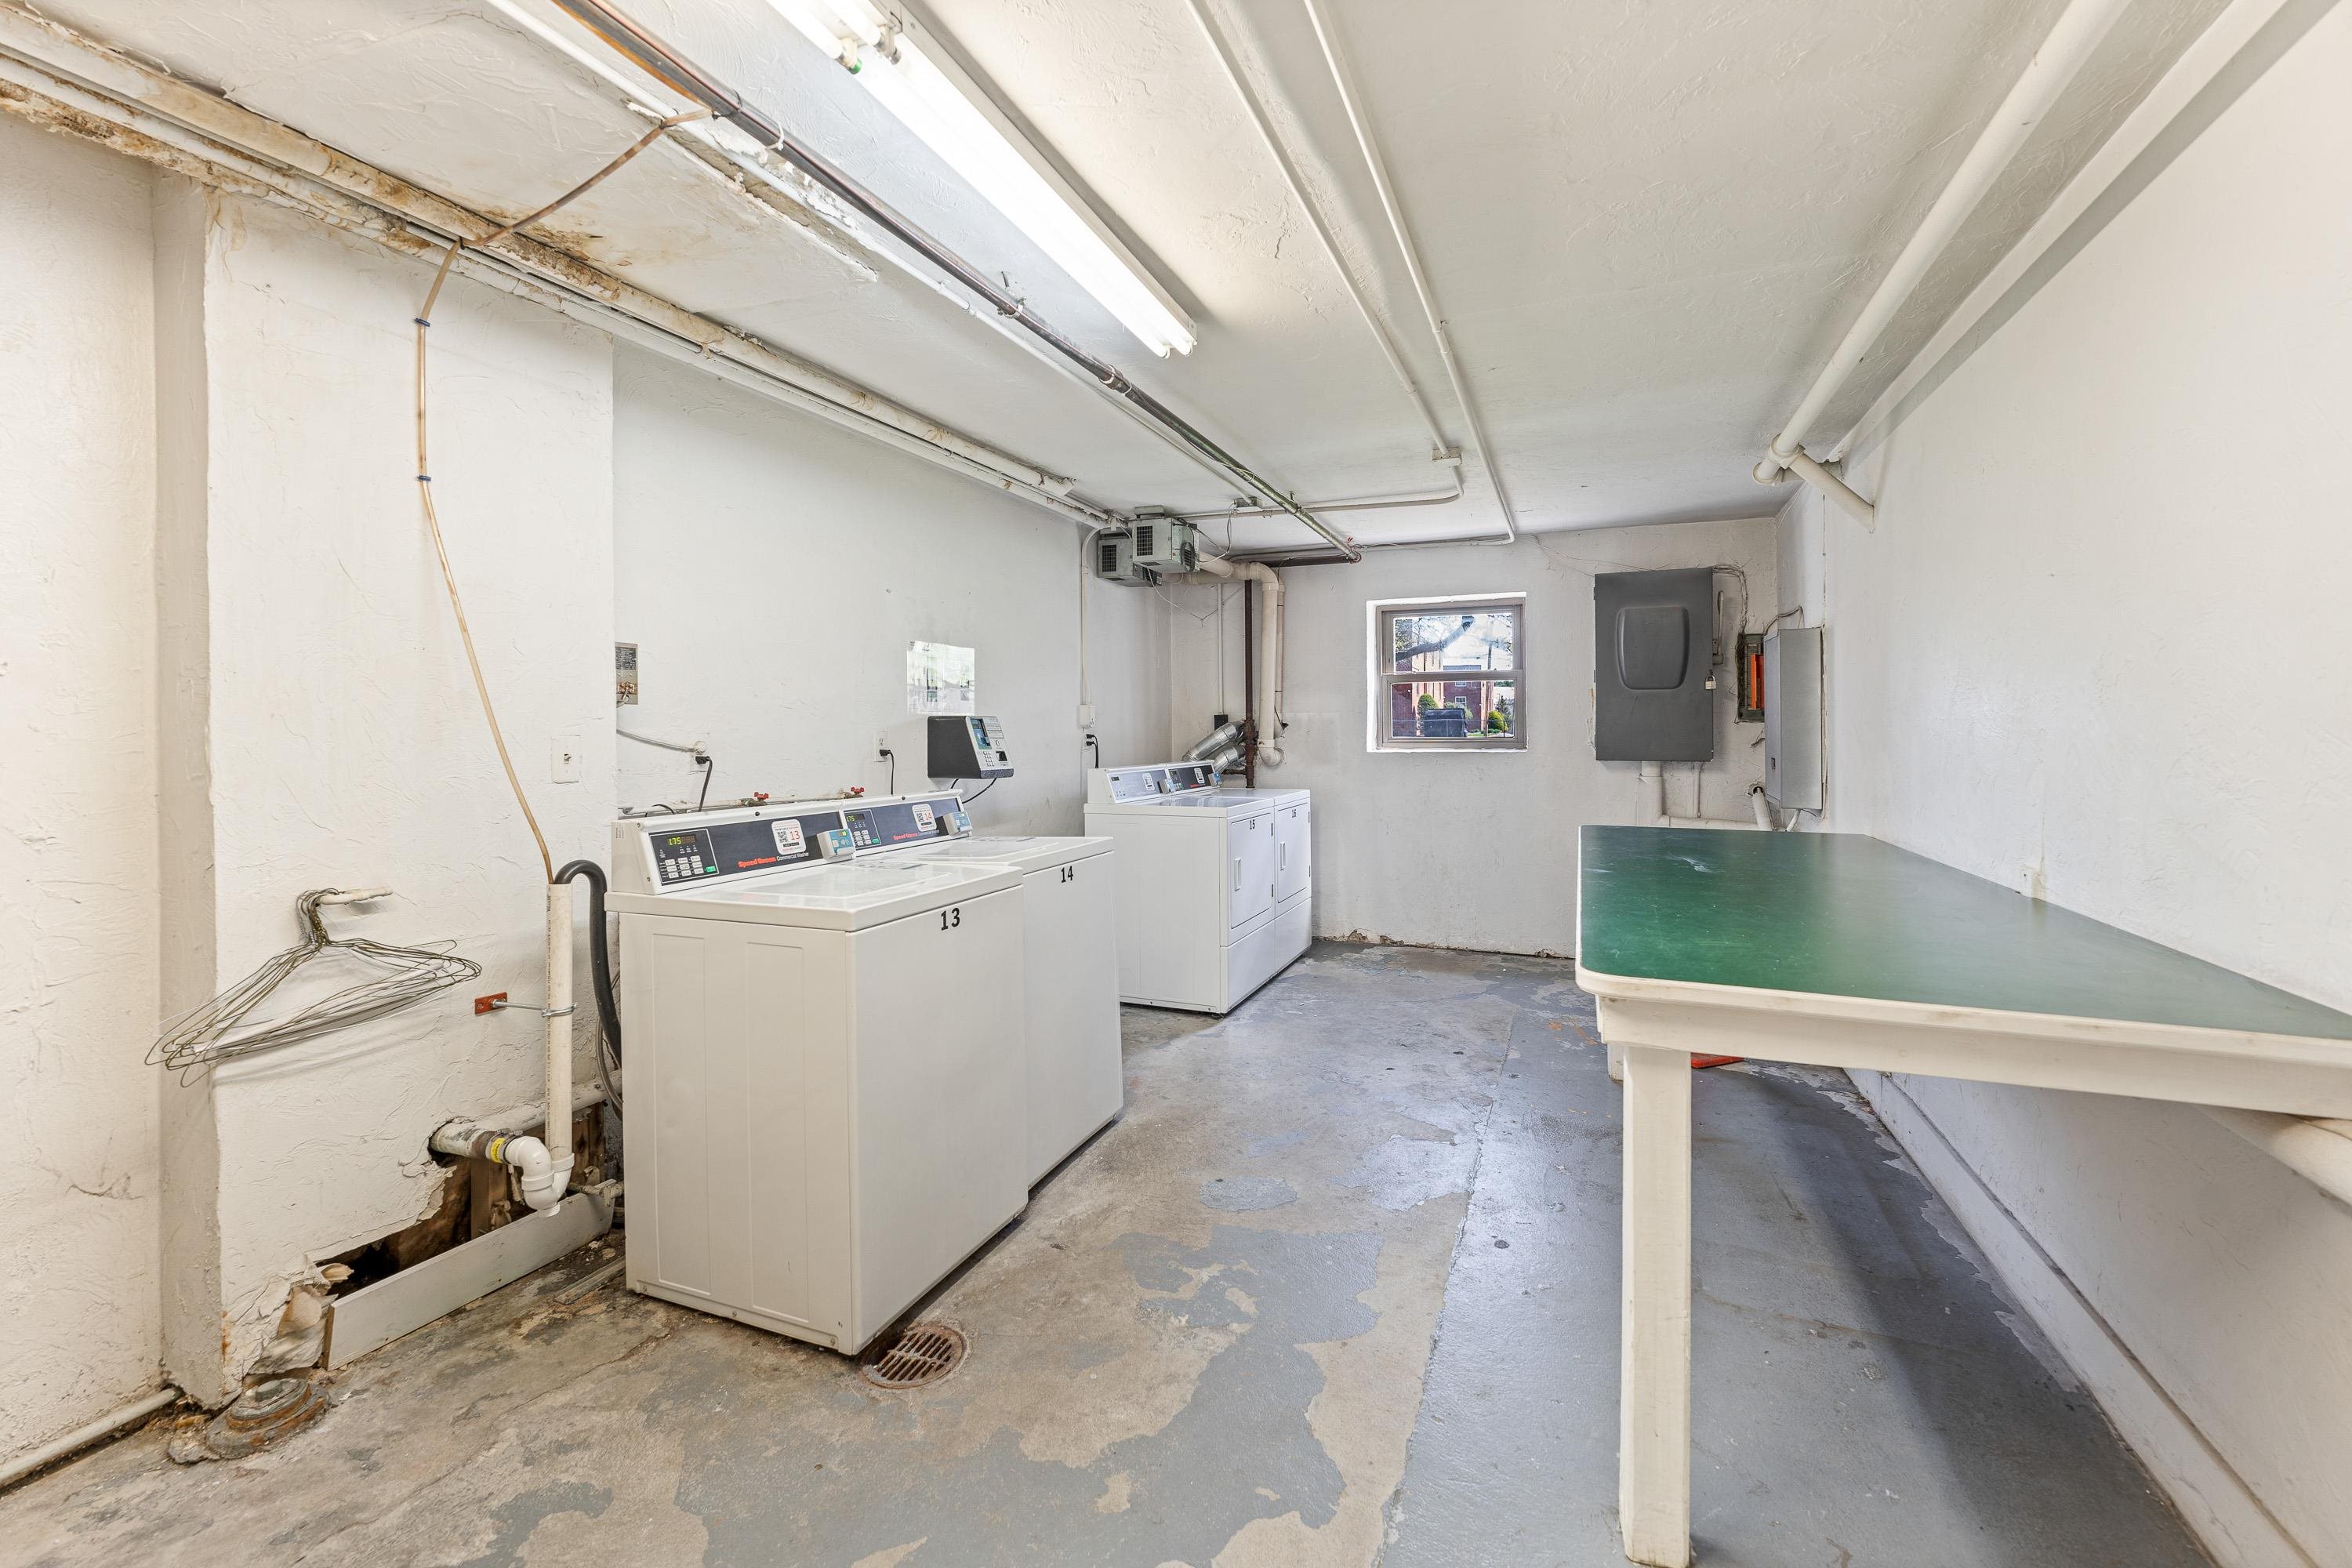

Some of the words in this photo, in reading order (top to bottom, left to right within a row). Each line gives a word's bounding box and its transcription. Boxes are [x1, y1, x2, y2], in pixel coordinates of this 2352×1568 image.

[924, 812, 932, 821] 14
[1250, 819, 1255, 829] 15
[789, 831, 800, 840] 13
[1061, 866, 1074, 883] 14
[941, 907, 960, 931] 13
